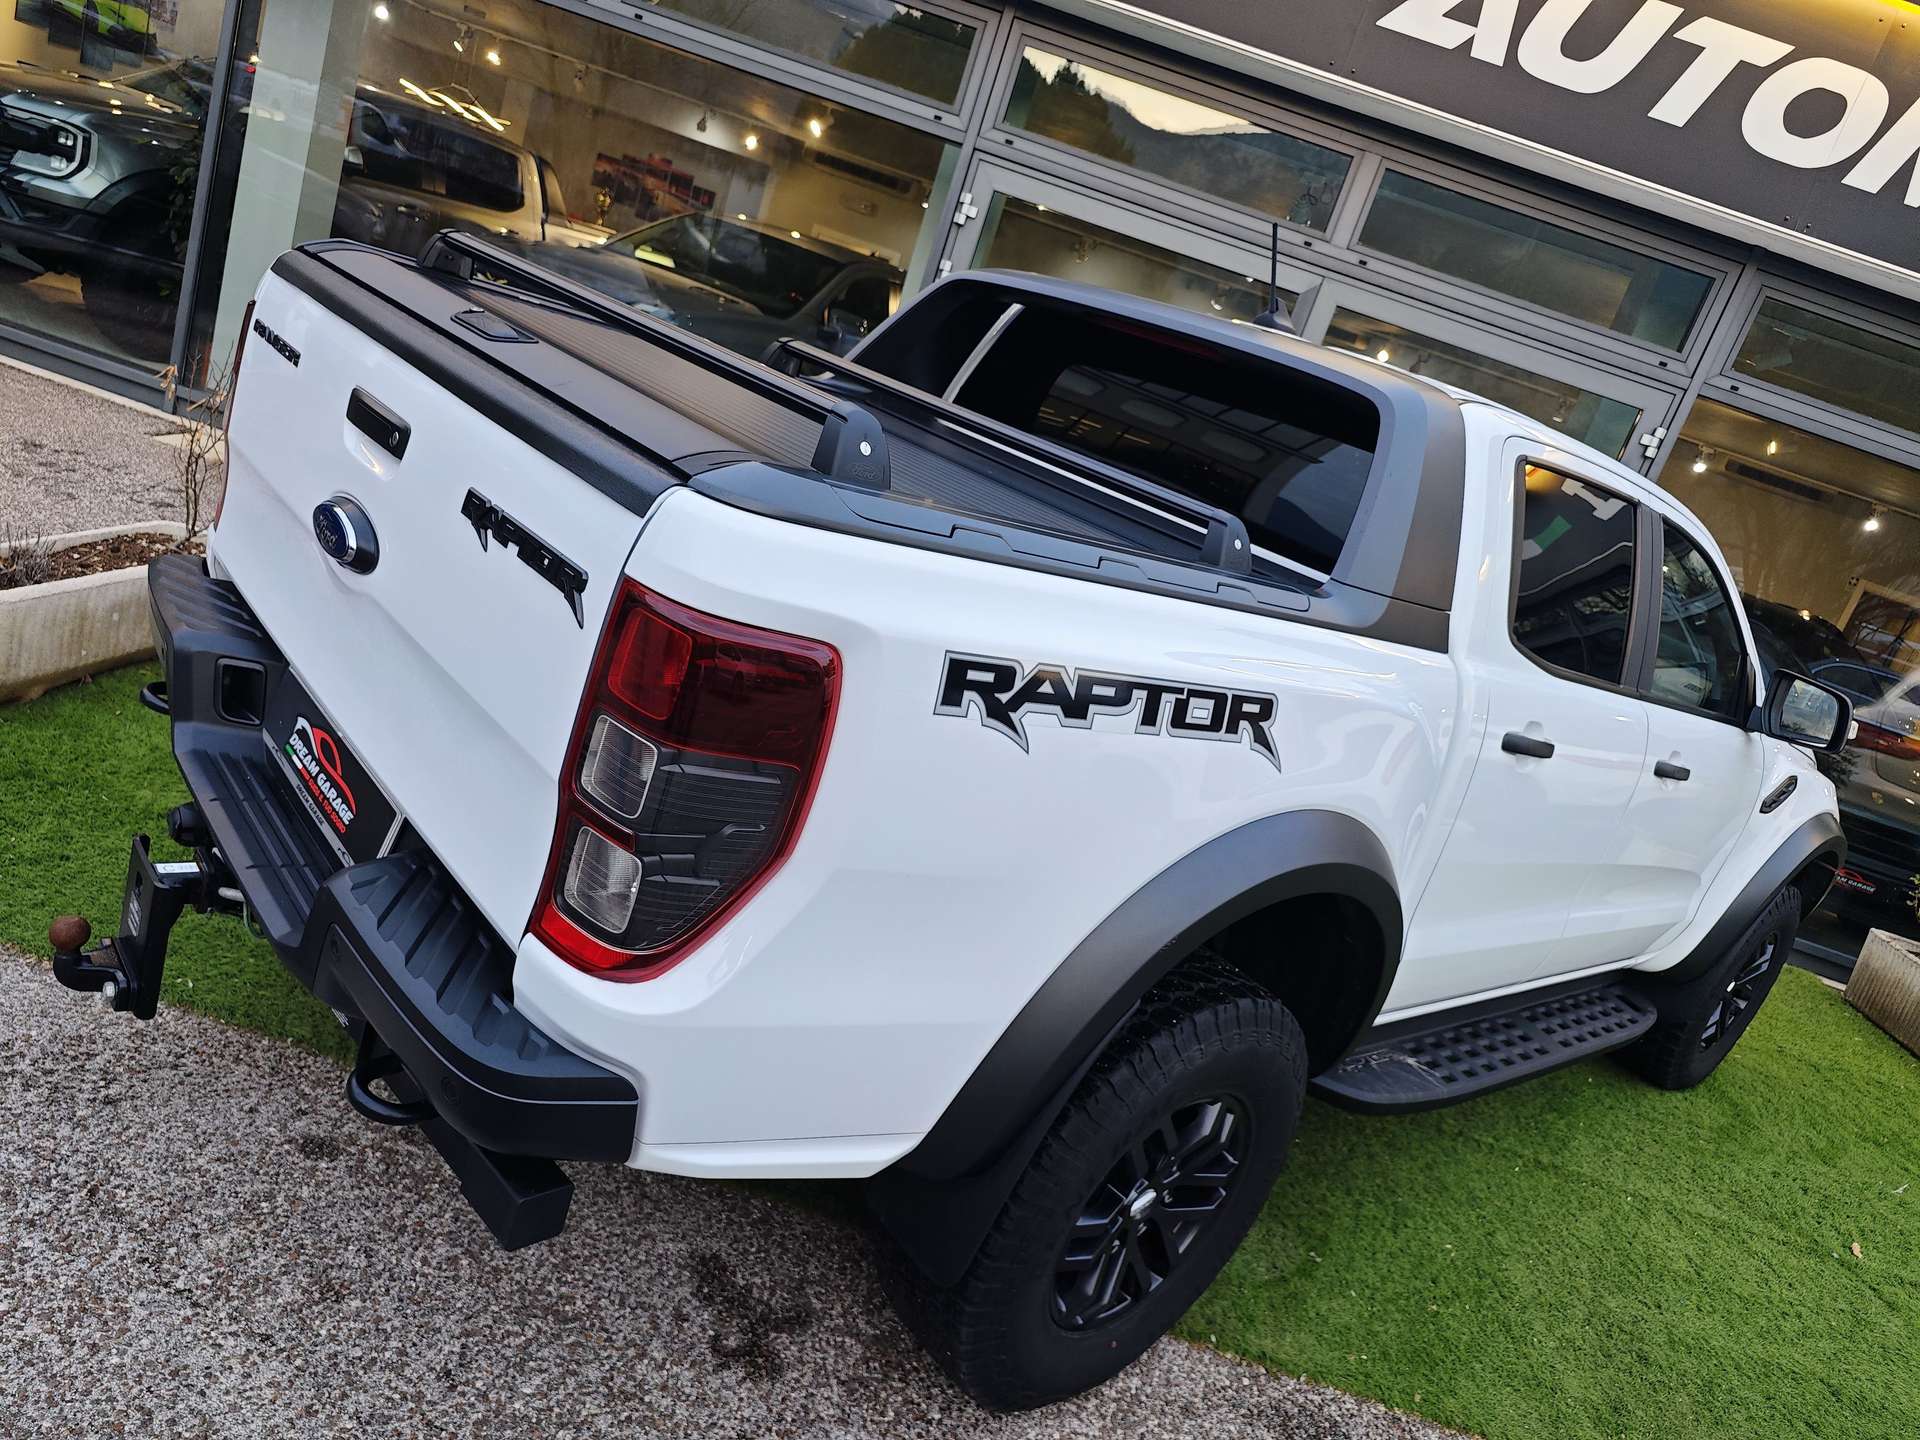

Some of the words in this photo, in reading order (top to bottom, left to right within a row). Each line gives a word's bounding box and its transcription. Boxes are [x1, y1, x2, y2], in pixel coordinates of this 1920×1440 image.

[461, 487, 589, 630] RAPTOR
[933, 650, 1281, 774] RAPTOR
[289, 732, 320, 777] DREAM
[317, 772, 354, 825] GARAGE
